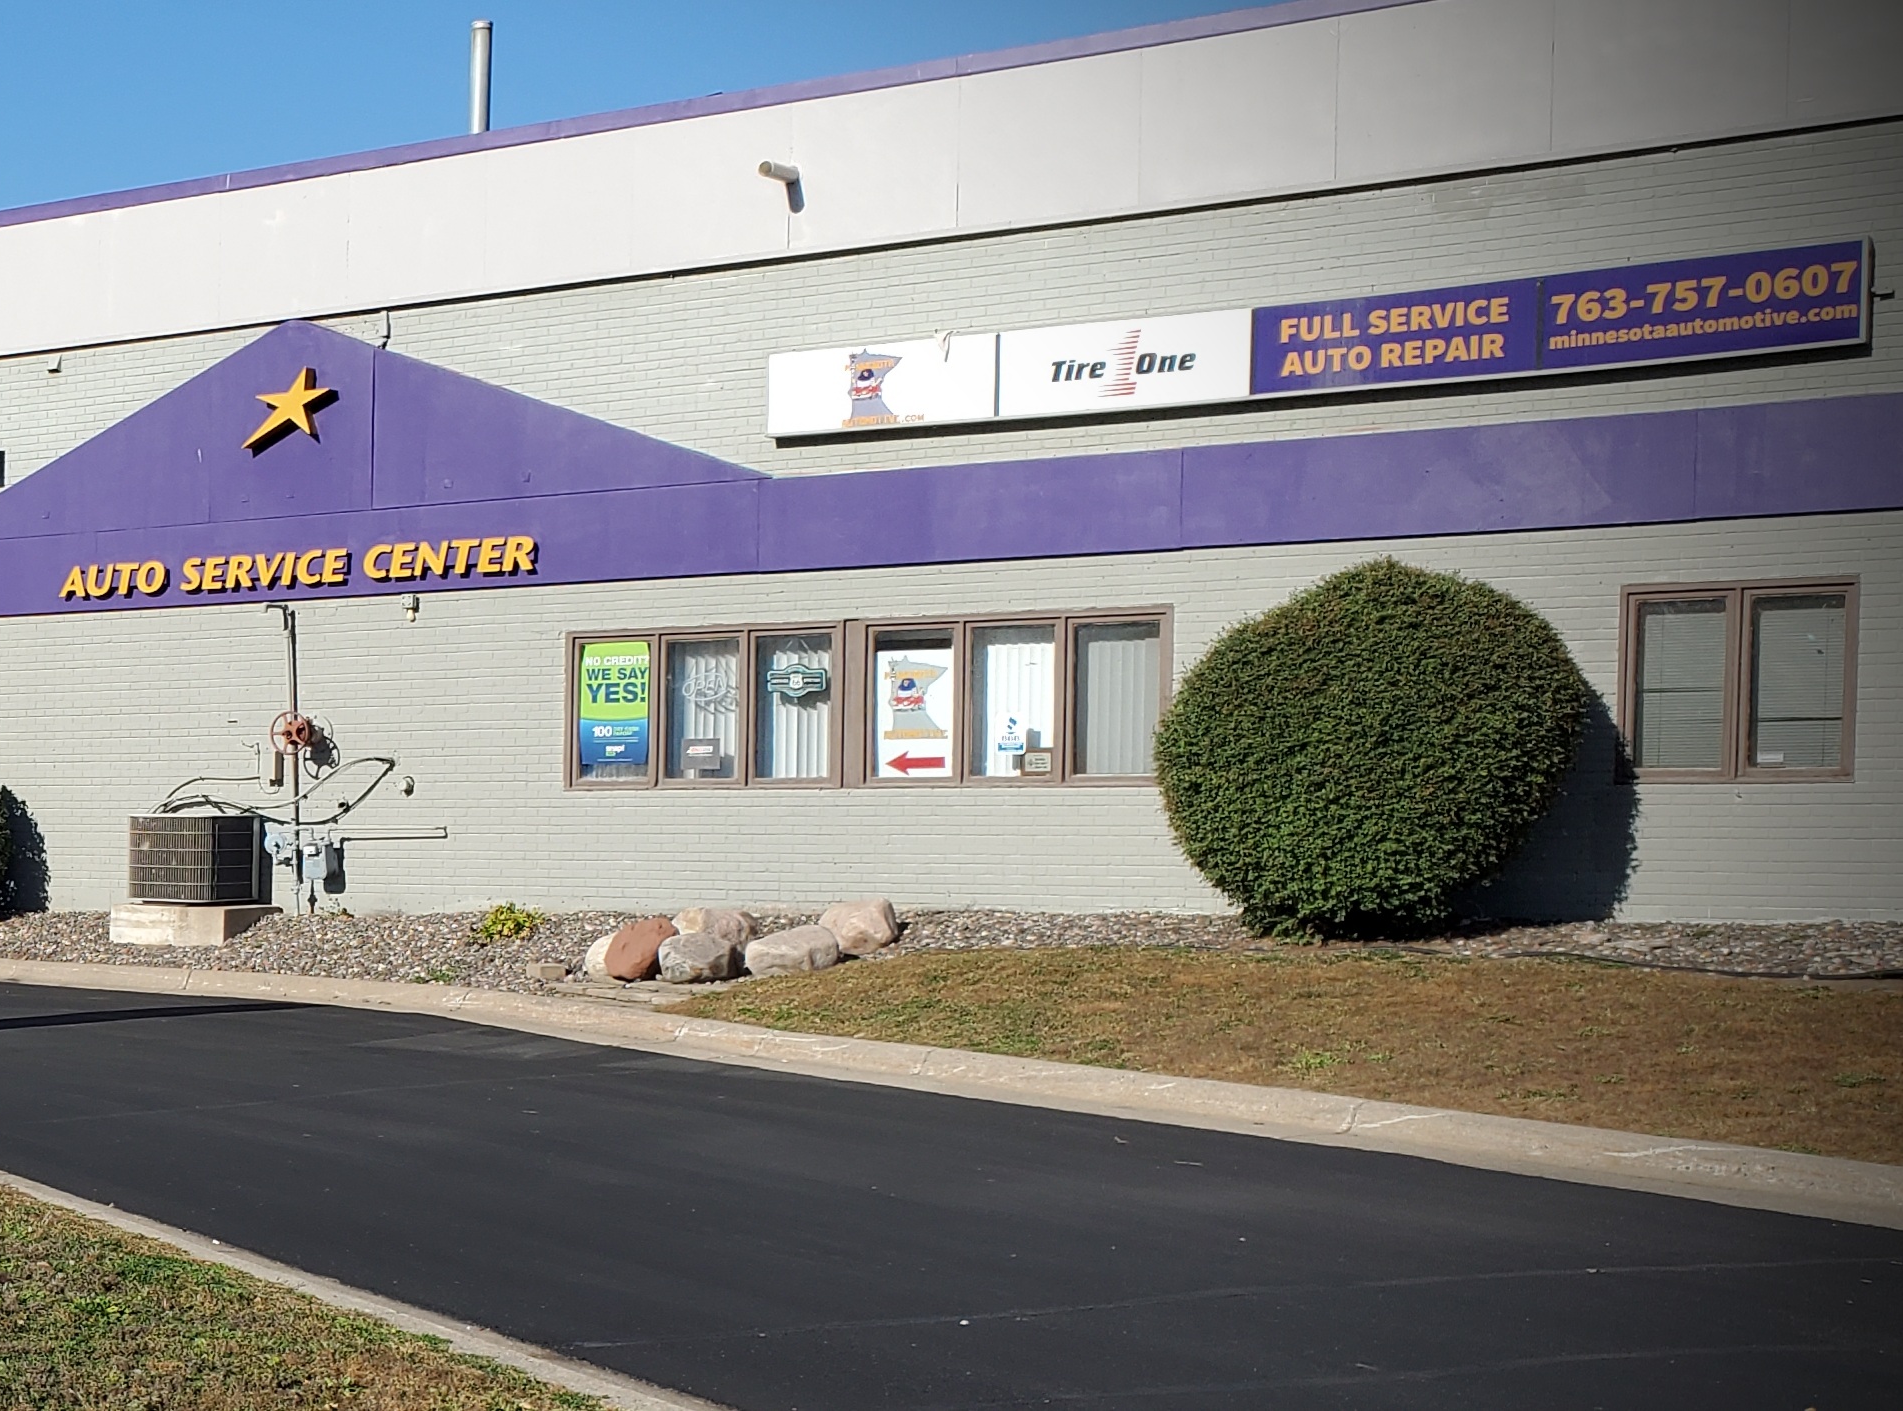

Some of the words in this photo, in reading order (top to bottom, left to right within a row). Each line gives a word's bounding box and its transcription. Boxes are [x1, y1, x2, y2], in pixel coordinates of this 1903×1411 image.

[1550, 261, 1858, 325] 763-757-0607
[1280, 313, 1359, 344] FULL
[1367, 297, 1510, 335] SERVICE
[1549, 300, 1858, 351] minnesotaautomotive.com
[1051, 358, 1106, 383] Tire
[1136, 351, 1196, 375] One
[1281, 345, 1372, 377] AUTO
[1380, 333, 1505, 367] REPAIR
[58, 561, 166, 599] AUTO
[180, 547, 349, 592] SERVICE
[363, 535, 535, 581] CENTER
[585, 656, 601, 666] NO
[604, 655, 649, 666] CREDIT?
[586, 668, 612, 681] WE
[617, 667, 649, 680] SAY
[586, 682, 647, 704] YES!
[682, 676, 726, 696] OPEN
